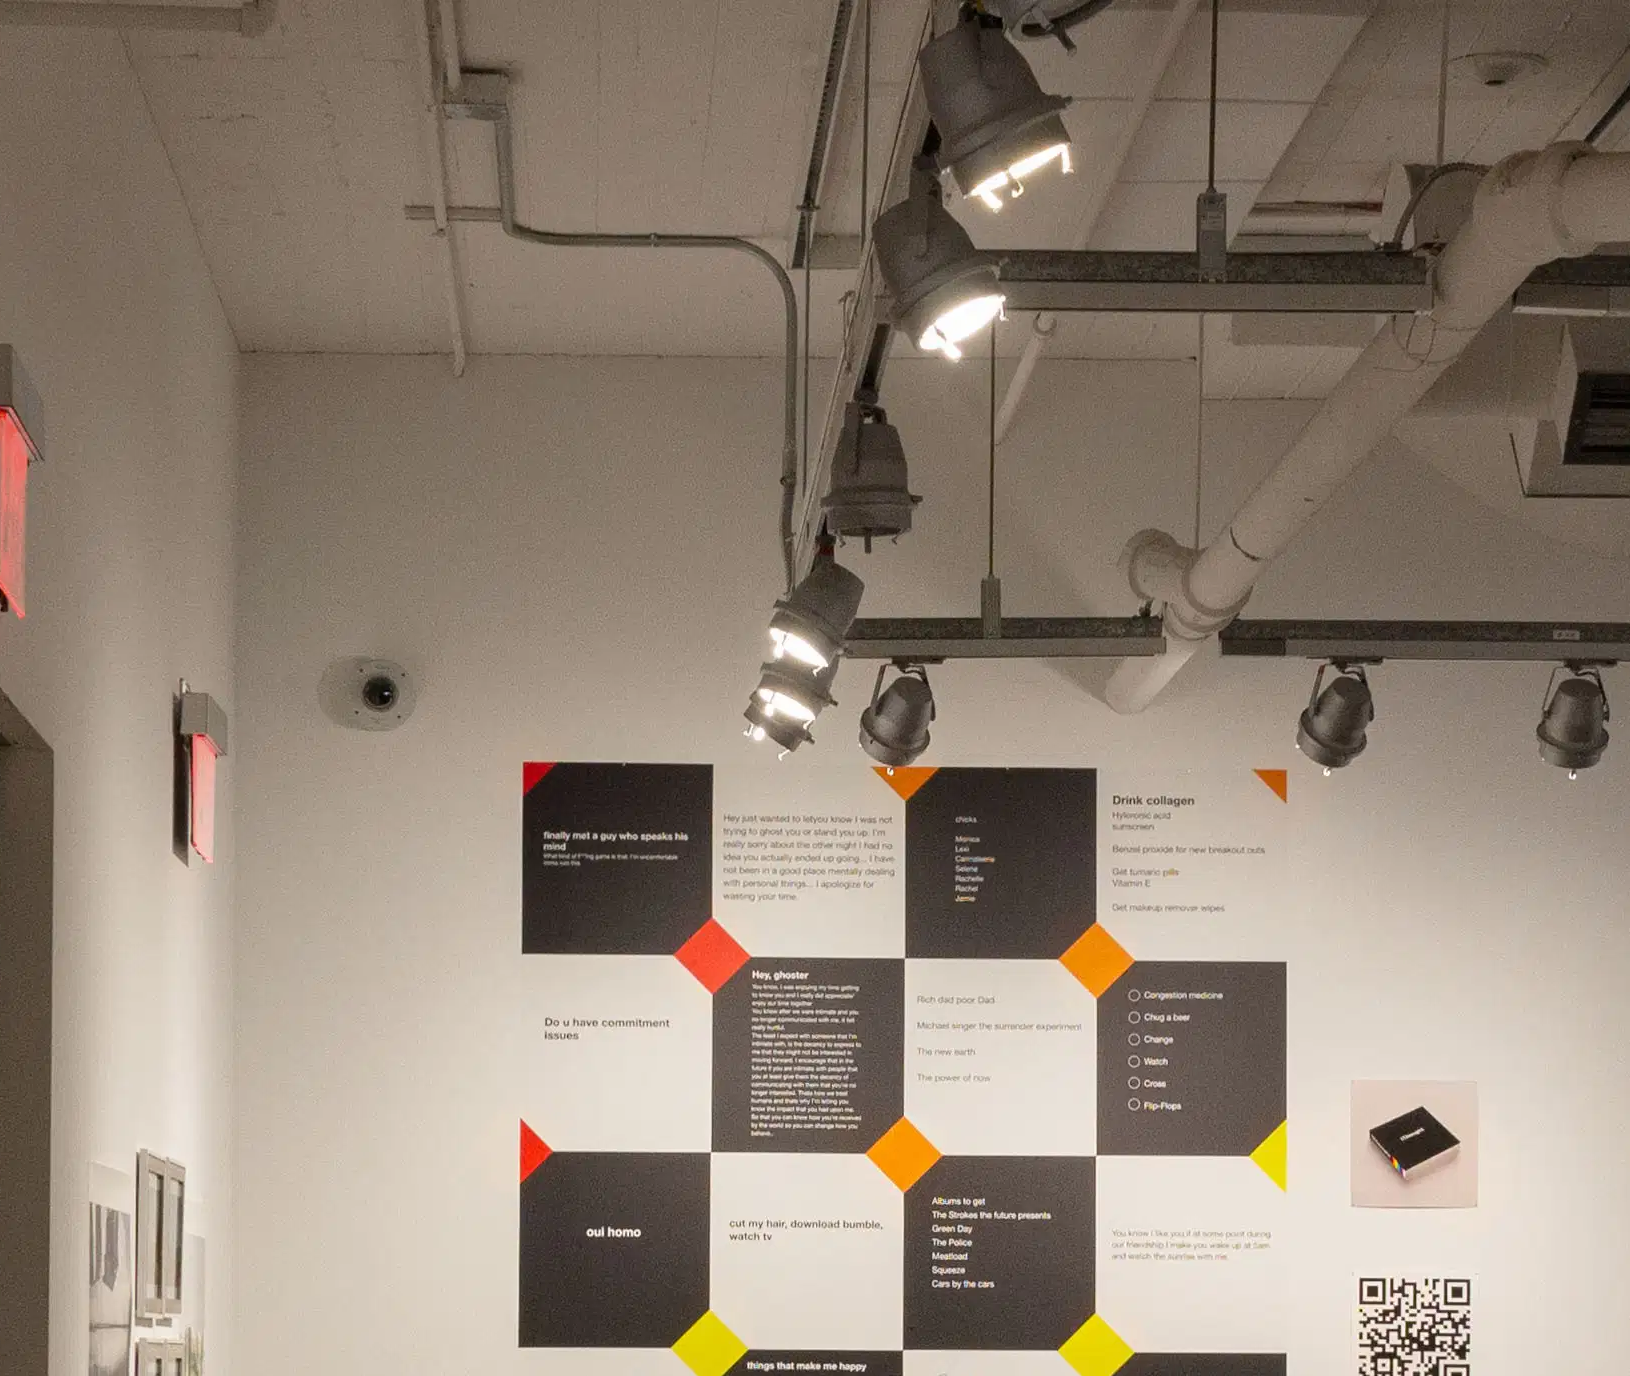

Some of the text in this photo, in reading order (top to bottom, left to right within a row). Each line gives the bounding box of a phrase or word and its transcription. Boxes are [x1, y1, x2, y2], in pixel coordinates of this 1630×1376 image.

[1112, 795, 1195, 807] Drink collagen
[543, 831, 571, 842] finally
[572, 832, 590, 840] met
[600, 833, 617, 842] guy
[618, 832, 639, 841] who
[640, 832, 673, 842] speaks
[674, 832, 689, 841] his
[543, 842, 566, 851] mind
[752, 970, 809, 981] Hey, ghoster
[544, 1017, 560, 1027] Do
[572, 1018, 599, 1027] have
[601, 1019, 669, 1027] commitment
[1144, 1013, 1165, 1023] Chug
[1173, 1013, 1190, 1021] beer
[544, 1031, 579, 1040] issues
[1143, 1035, 1174, 1045] Change
[1143, 1057, 1168, 1066] Watch
[1143, 1079, 1166, 1088] Cross
[931, 1197, 986, 1207] Albums to get
[729, 1220, 883, 1229] cut my hair, download bumble,
[931, 1224, 973, 1234] Green Day
[729, 1232, 772, 1241] watch tv
[932, 1238, 973, 1247] The Police
[932, 1265, 966, 1275] Squeeze
[931, 1279, 951, 1288] Cars
[951, 1280, 962, 1290] by
[963, 1280, 976, 1288] the
[746, 1361, 775, 1372] things
[776, 1361, 795, 1370] that
[796, 1361, 821, 1370] make
[839, 1362, 867, 1372] happy
